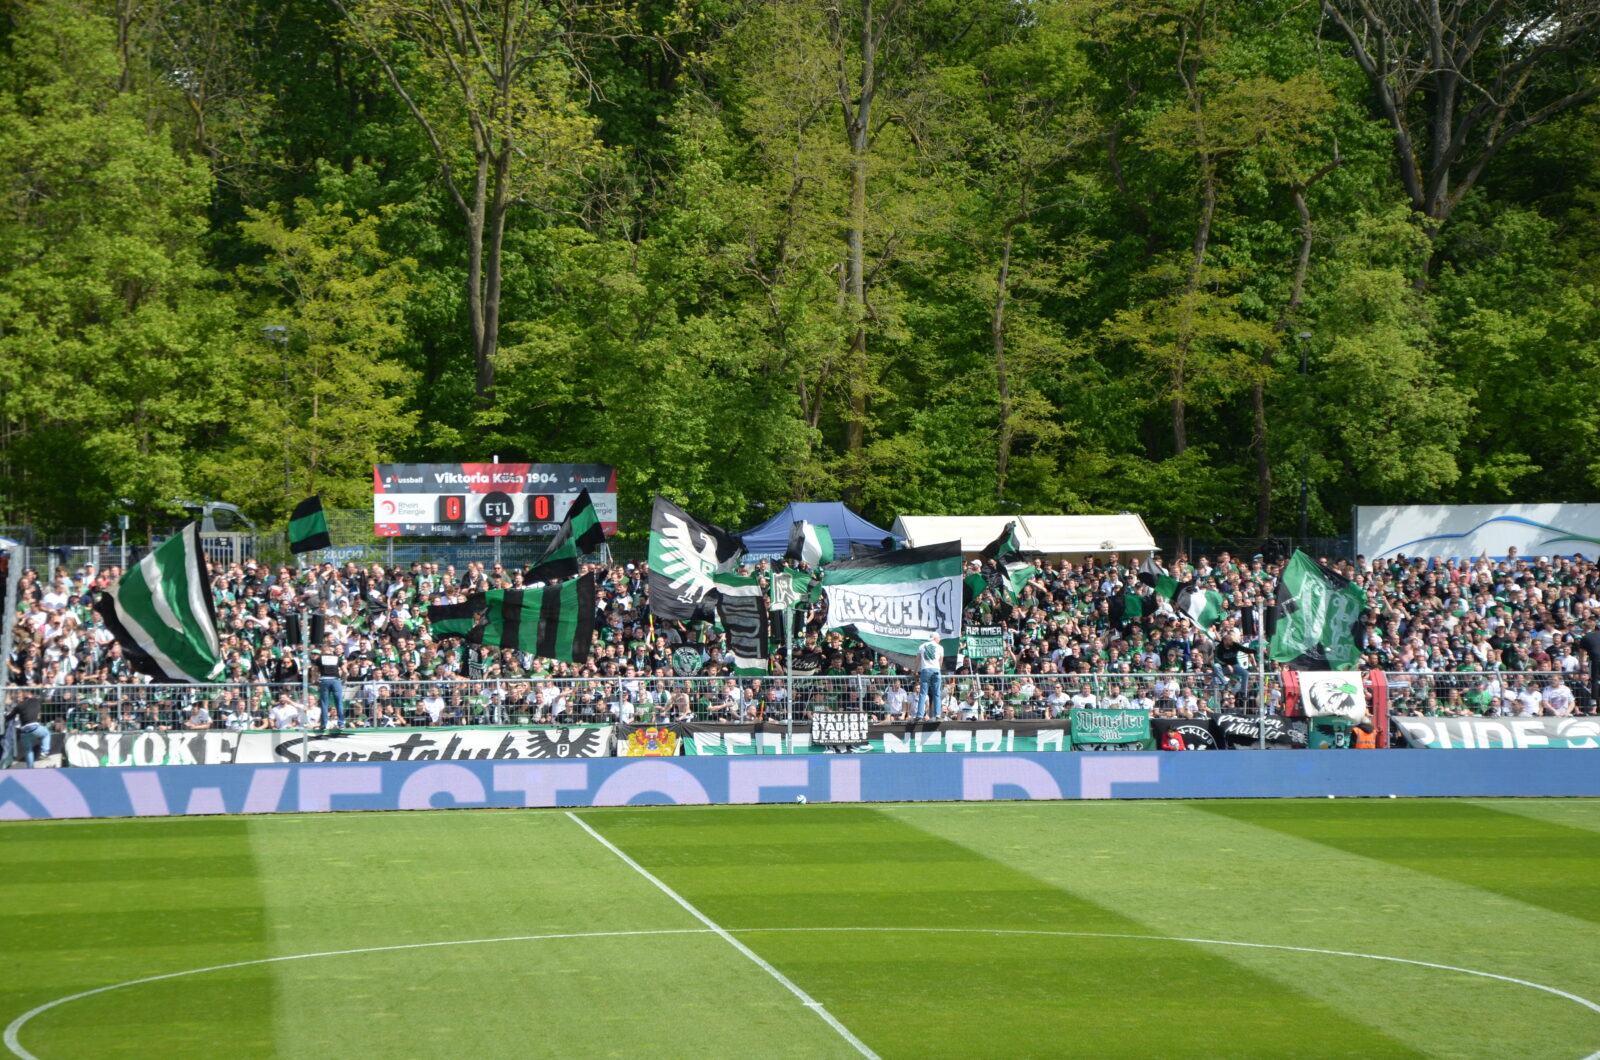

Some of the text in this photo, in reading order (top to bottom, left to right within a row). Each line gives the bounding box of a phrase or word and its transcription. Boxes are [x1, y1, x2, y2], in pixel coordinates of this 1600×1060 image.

[434, 473, 558, 484] Viktoria Köln 1904
[447, 497, 460, 520] 0
[535, 496, 549, 519] 0
[812, 722, 868, 731] STADION
[1225, 723, 1285, 739] Münter
[812, 731, 868, 740] VERBOT
